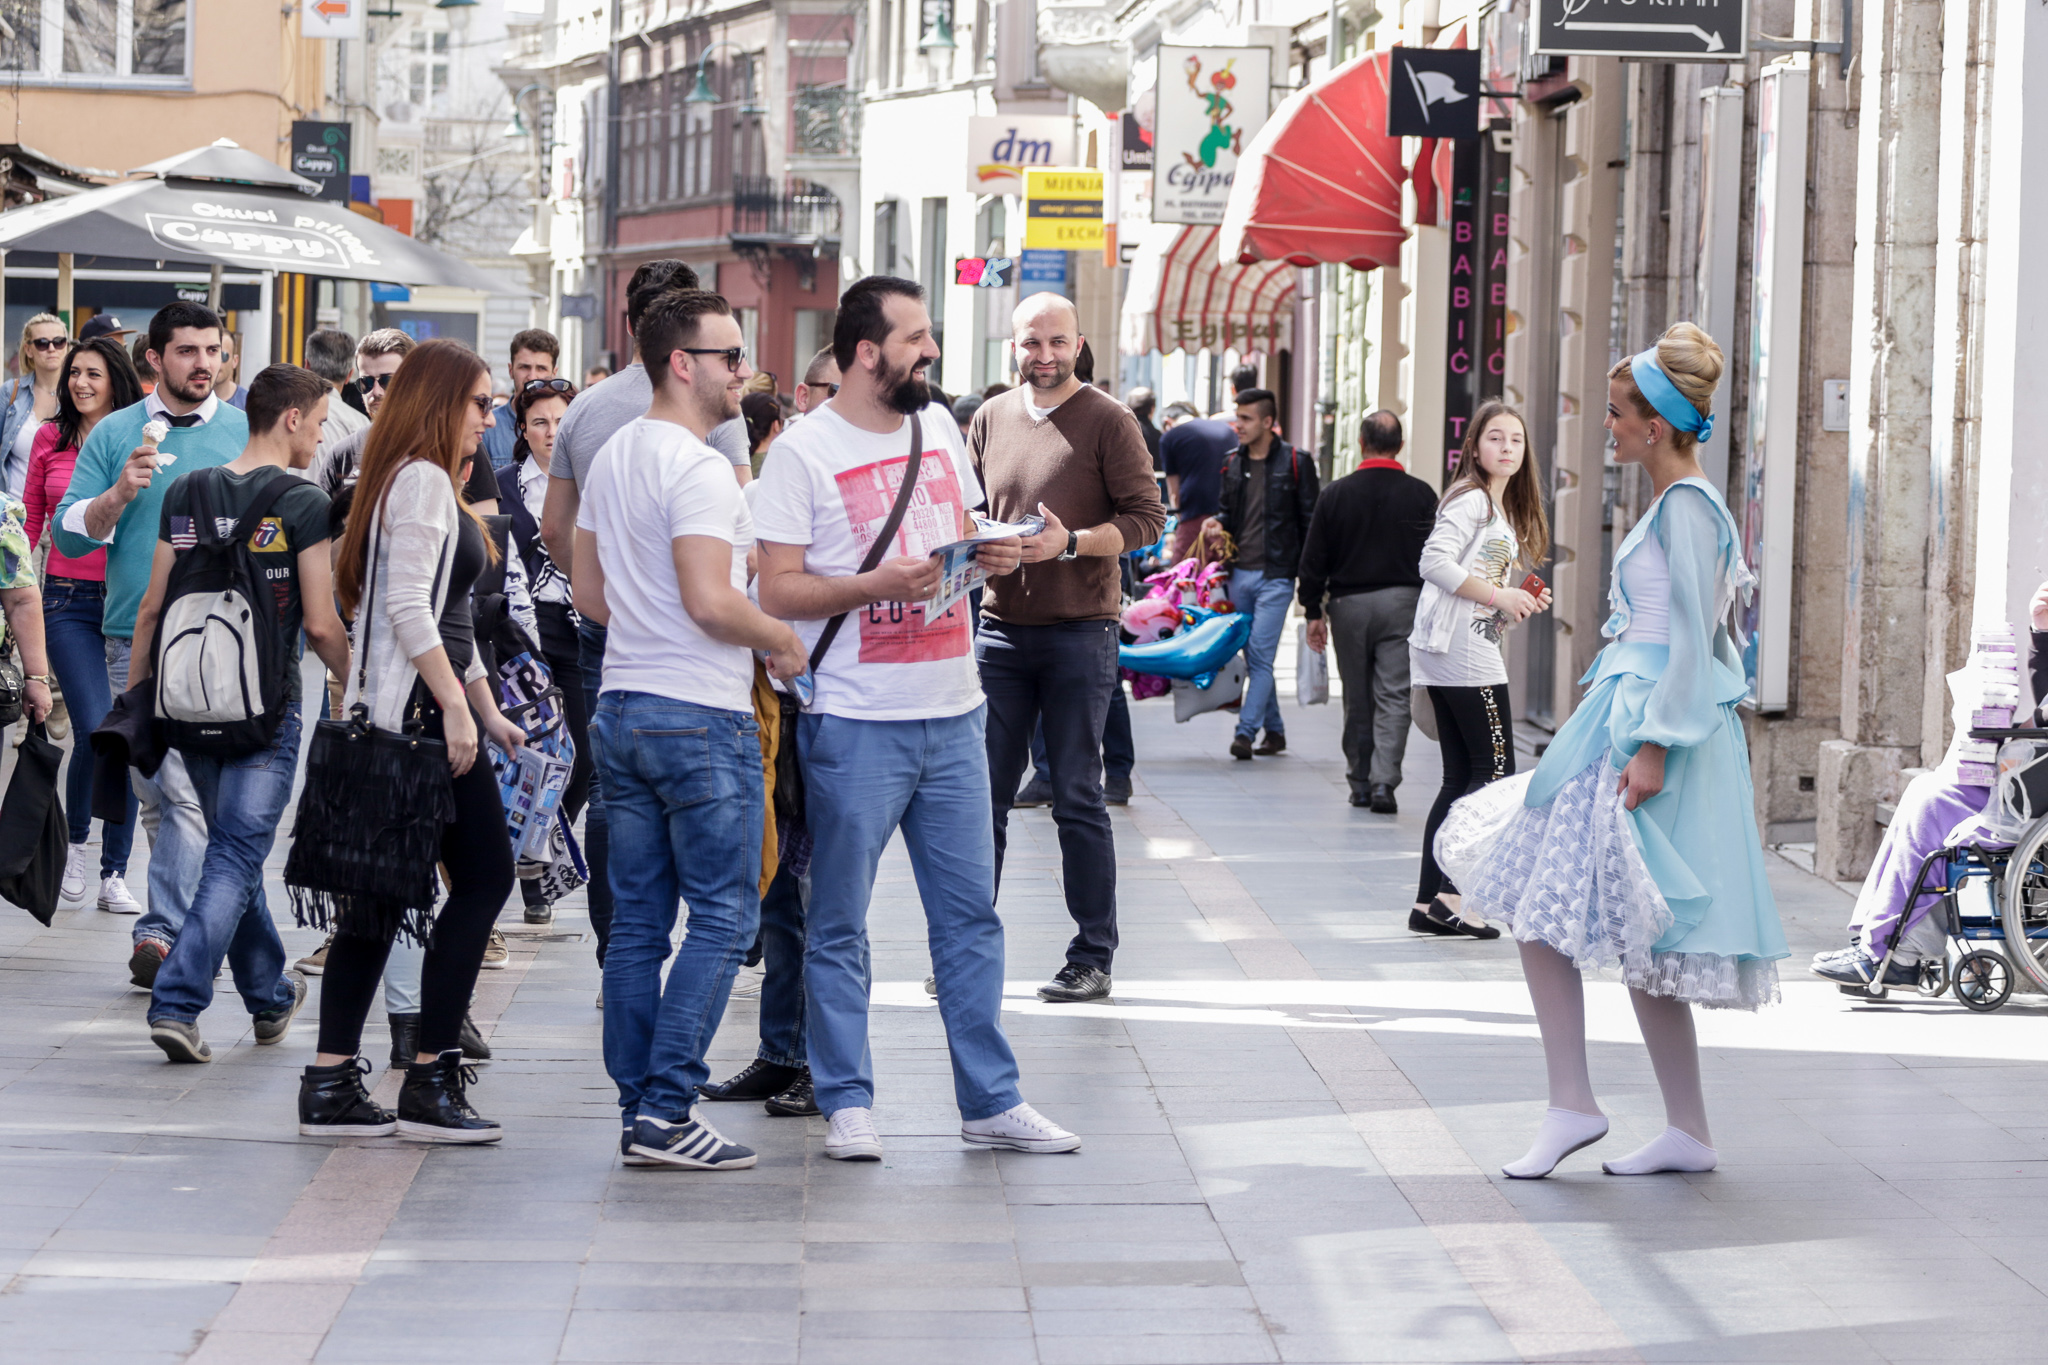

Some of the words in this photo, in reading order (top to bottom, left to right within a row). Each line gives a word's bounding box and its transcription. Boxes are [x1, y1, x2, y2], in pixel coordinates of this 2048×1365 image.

[992, 127, 1052, 163] dm
[297, 155, 333, 172] Cappy
[192, 202, 278, 223] Okusi
[162, 222, 327, 258] Cappy
[1450, 221, 1472, 374] BABIĆ
[911, 505, 935, 521] 20320
[914, 516, 938, 531] 44800
[263, 567, 290, 580] OUR
